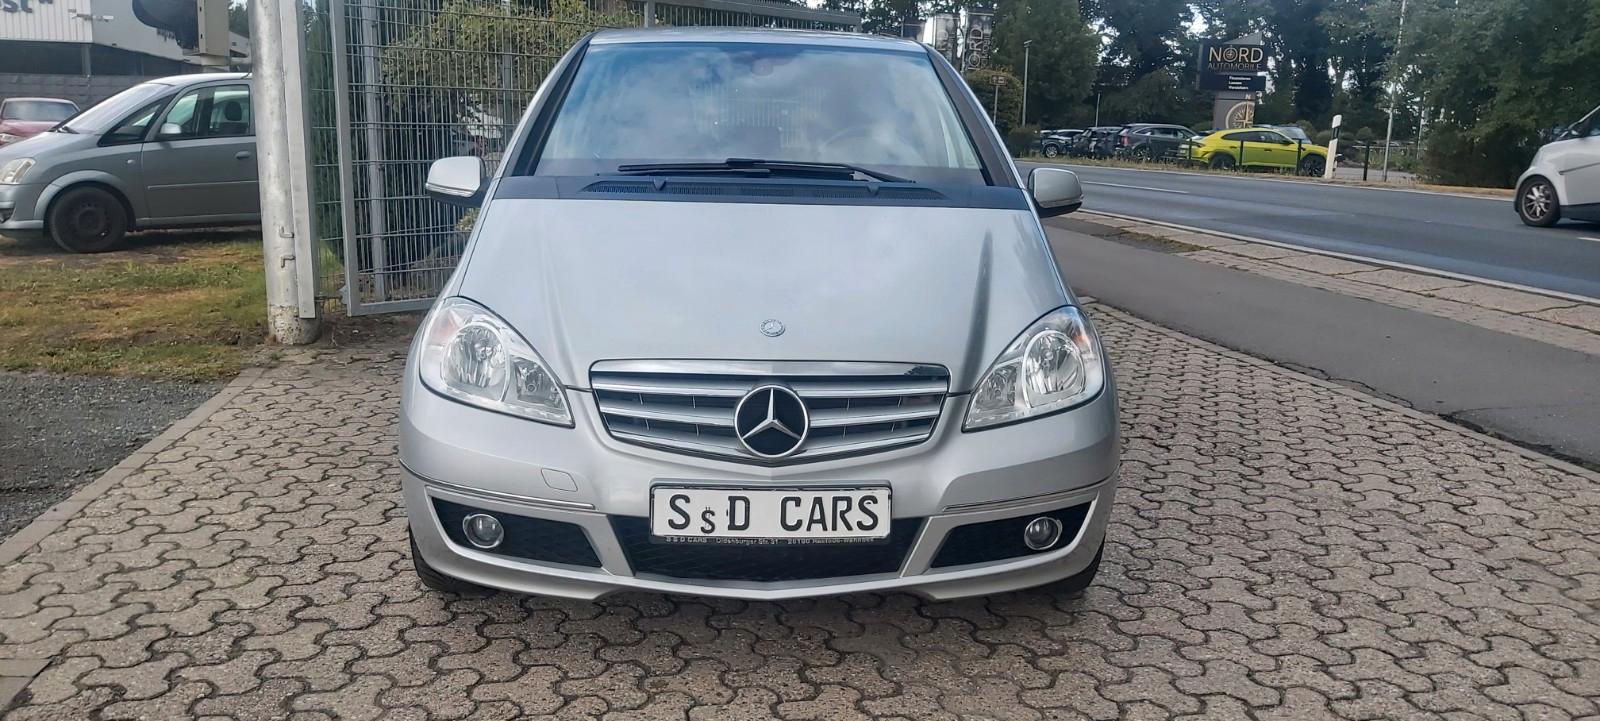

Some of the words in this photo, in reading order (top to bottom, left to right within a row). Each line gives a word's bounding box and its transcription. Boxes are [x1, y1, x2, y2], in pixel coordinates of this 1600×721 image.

[1209, 46, 1263, 63] NORD
[1208, 63, 1261, 71] AUTOMOBILE
[668, 494, 690, 530] S
[727, 495, 750, 531] D
[780, 495, 878, 532] CARS
